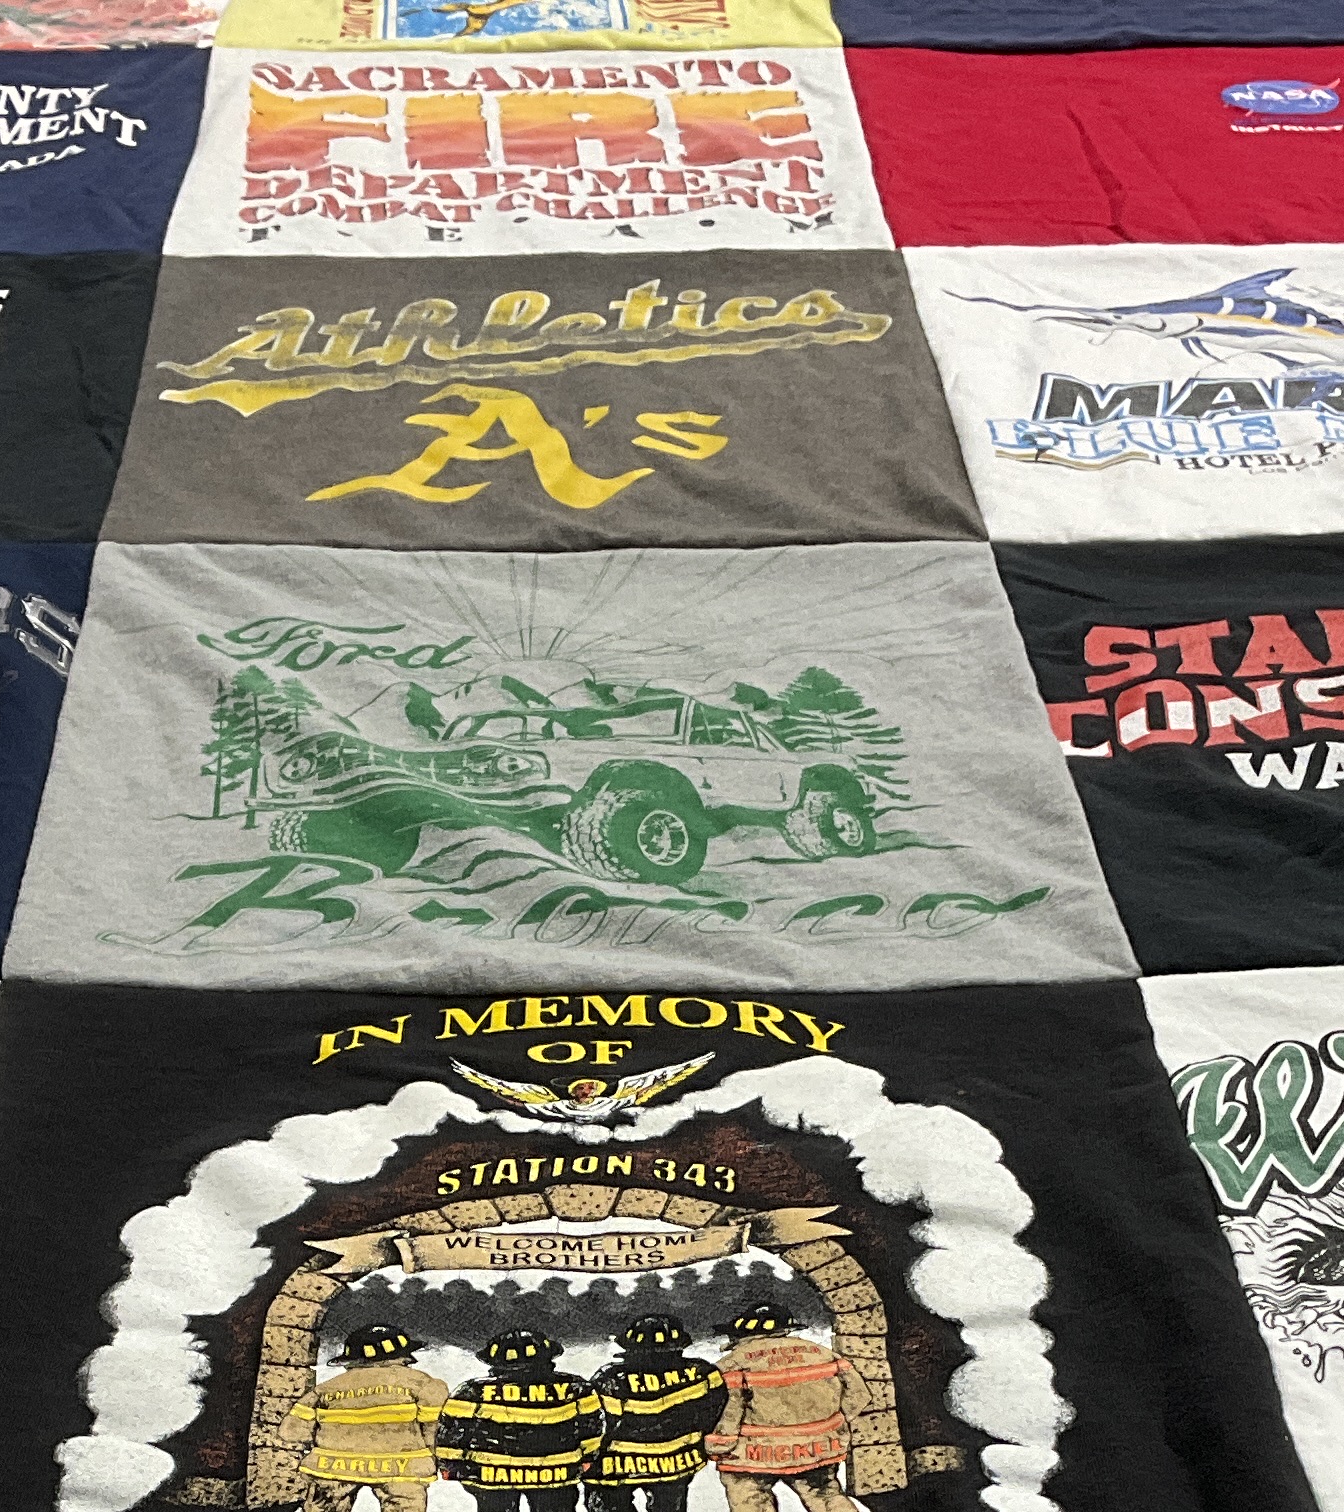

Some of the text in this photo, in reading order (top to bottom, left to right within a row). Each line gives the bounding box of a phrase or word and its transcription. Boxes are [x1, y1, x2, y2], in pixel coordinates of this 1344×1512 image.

[251, 59, 792, 92] SACRAMENTO
[1230, 86, 1334, 106] NASA
[242, 85, 824, 171] FIRE
[240, 160, 825, 201] DEPARTMENT
[238, 186, 837, 224] COMBAT CHALLENGE
[984, 414, 1283, 460] BLUE
[1175, 453, 1306, 470] HOTEL
[196, 615, 478, 673] Ford
[311, 993, 848, 1065] IN MEMORY
[525, 1040, 633, 1066] OF
[436, 1154, 737, 1196] STATION 343
[444, 1230, 709, 1256] WELCOME HOME
[487, 1248, 668, 1268] BROTHERS
[481, 1382, 574, 1402] F.D.N.Y.
[628, 1366, 703, 1394] F.D.N.Y.
[601, 1449, 703, 1476] BLACKWELL
[744, 1438, 843, 1464] MICKEL
[480, 1466, 569, 1484] HANNON
